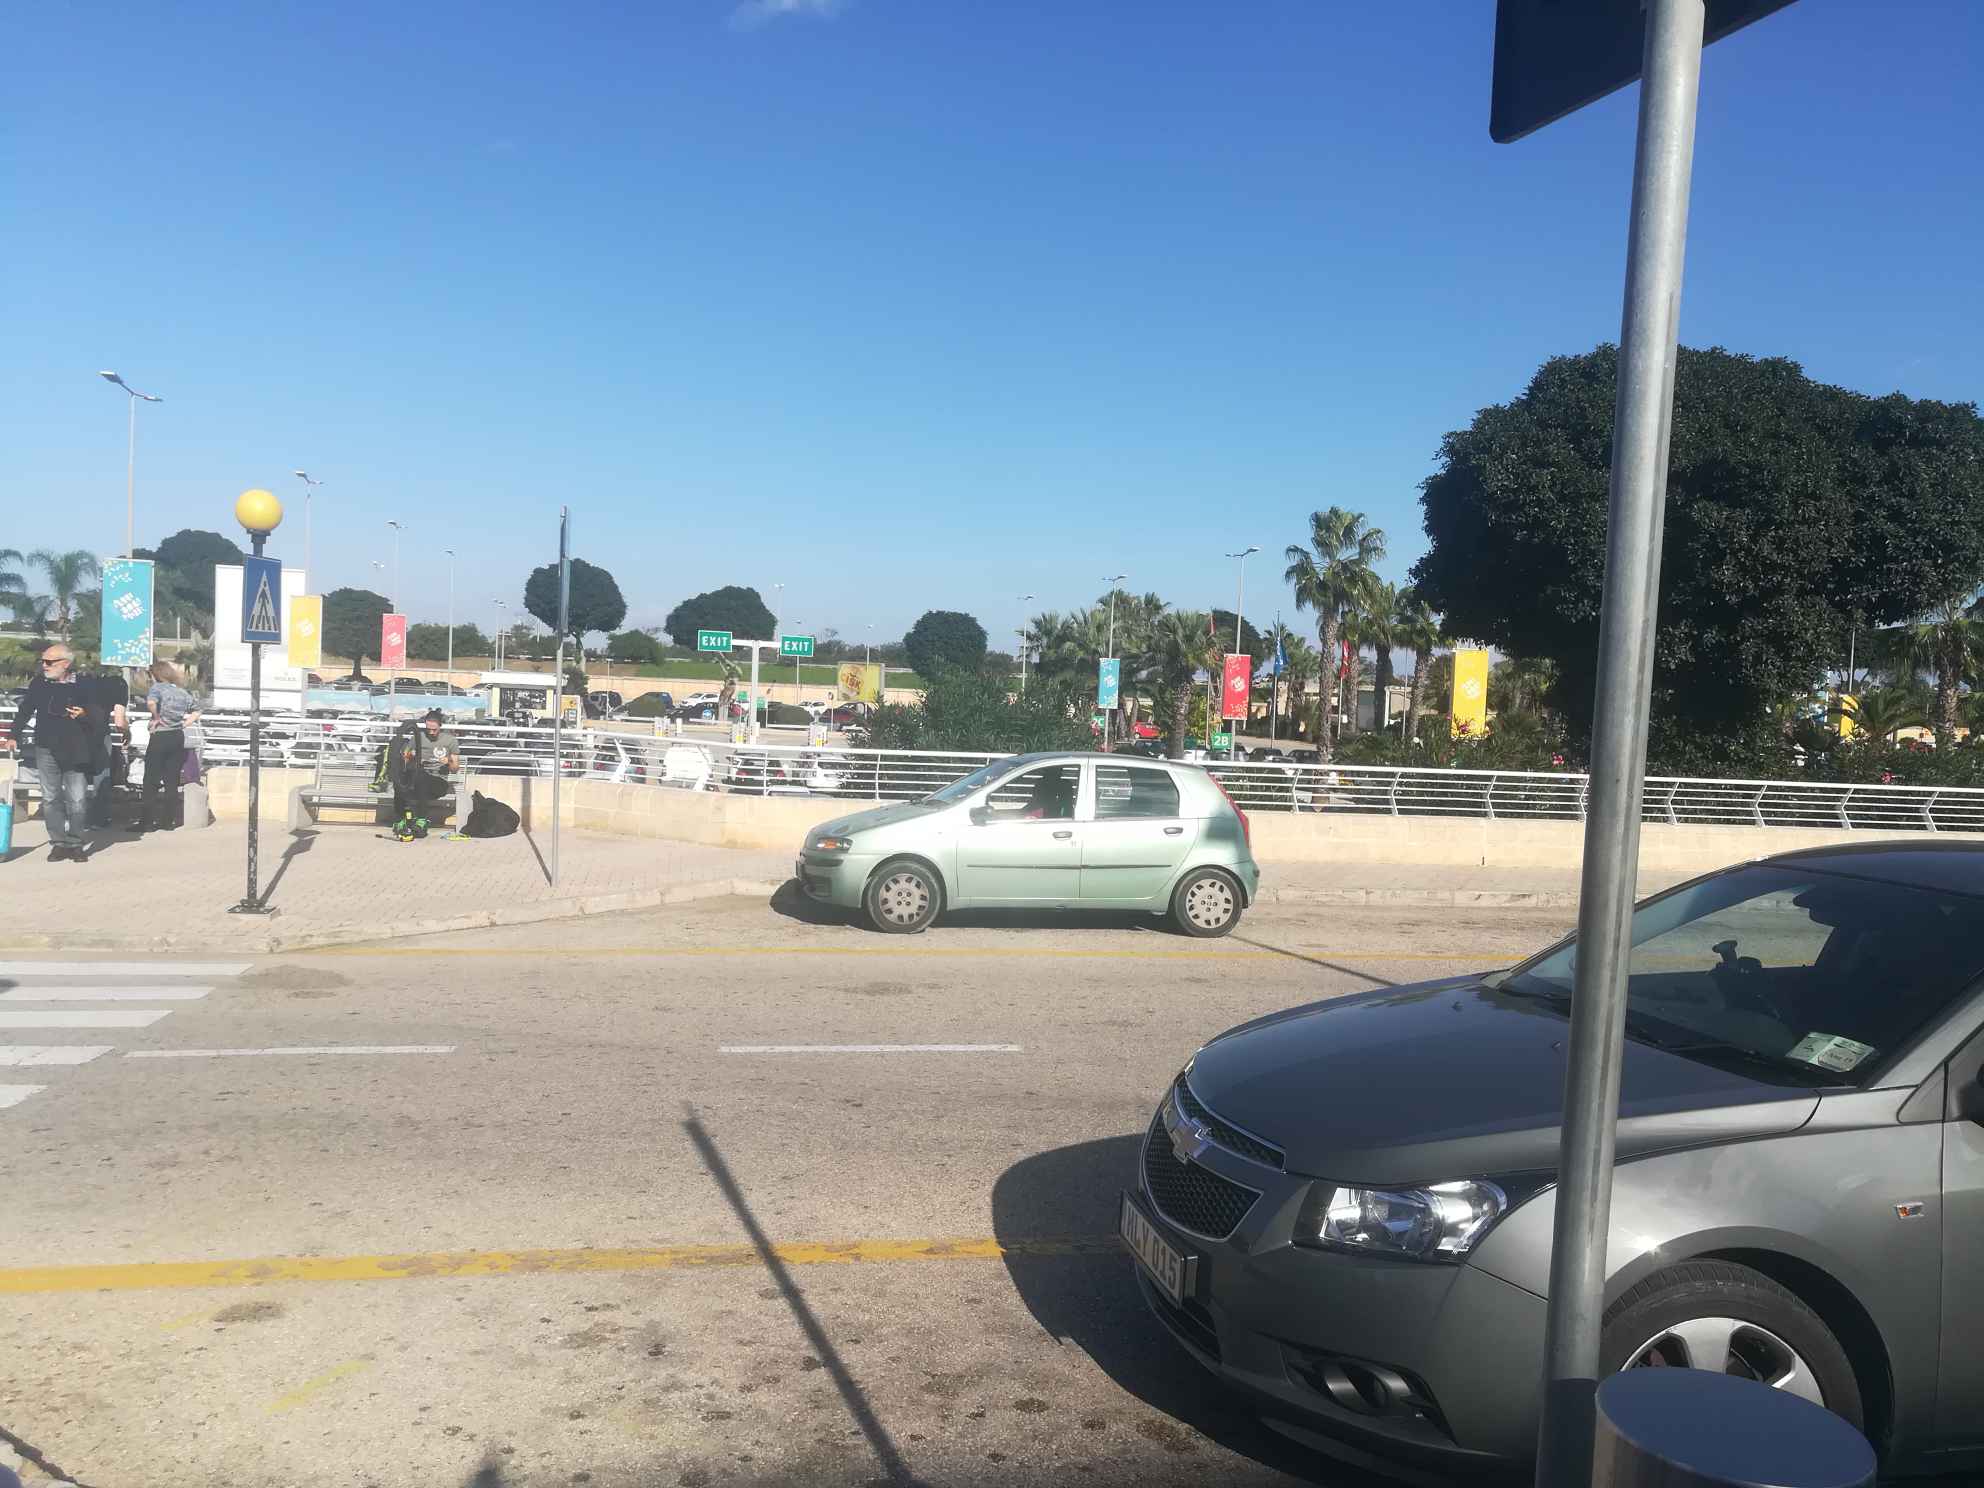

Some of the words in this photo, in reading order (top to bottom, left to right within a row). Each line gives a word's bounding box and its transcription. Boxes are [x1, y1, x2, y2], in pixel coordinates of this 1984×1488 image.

[702, 636, 727, 647] EXIT
[784, 641, 809, 652] EXIT
[1213, 735, 1229, 745] 2B
